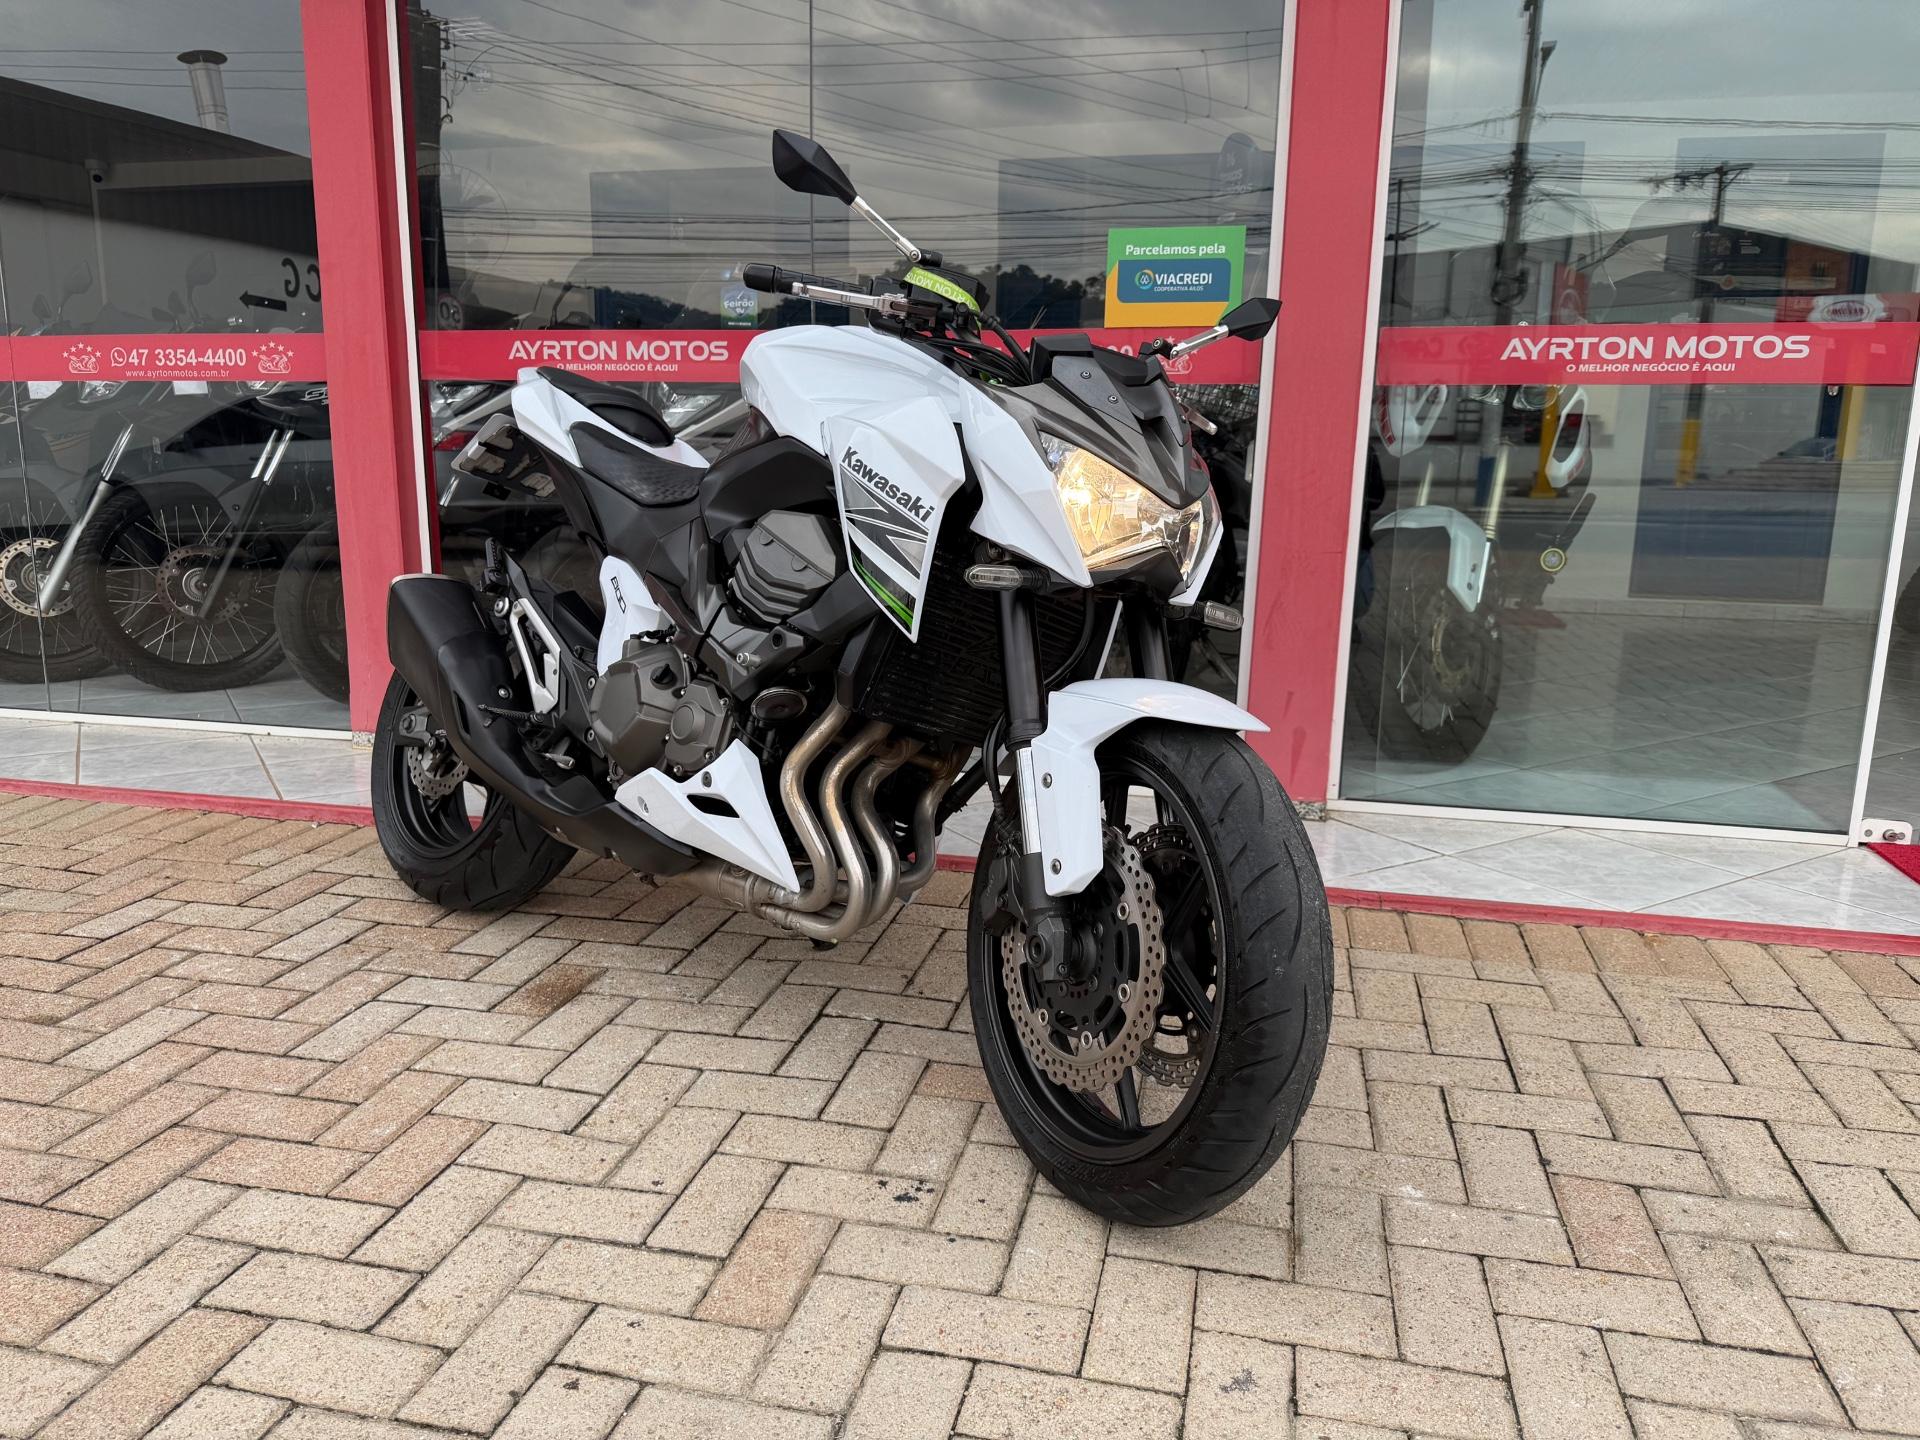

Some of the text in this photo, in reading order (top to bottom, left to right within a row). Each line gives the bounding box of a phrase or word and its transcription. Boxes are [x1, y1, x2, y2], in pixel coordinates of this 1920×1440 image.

[1125, 243, 1226, 256] Parcelamos pela
[1155, 273, 1212, 285] VIACREDI
[509, 340, 729, 361] AYRTON MOTOS
[1500, 336, 1654, 361] AYRTON
[1664, 335, 1811, 360] MOTOS
[128, 348, 247, 367] 47 3354-4400
[566, 363, 602, 371] MELHOR
[604, 362, 645, 371] NEGÓCIO
[654, 363, 679, 372] AQUI
[1566, 363, 1576, 373] O
[1578, 363, 1629, 372] MELHOR
[1632, 361, 1690, 372] NEGÓCIO
[1702, 363, 1736, 372] AQUI
[125, 369, 230, 379] www.ayrtonmotos.com.br
[841, 446, 935, 524] Kawasaki
